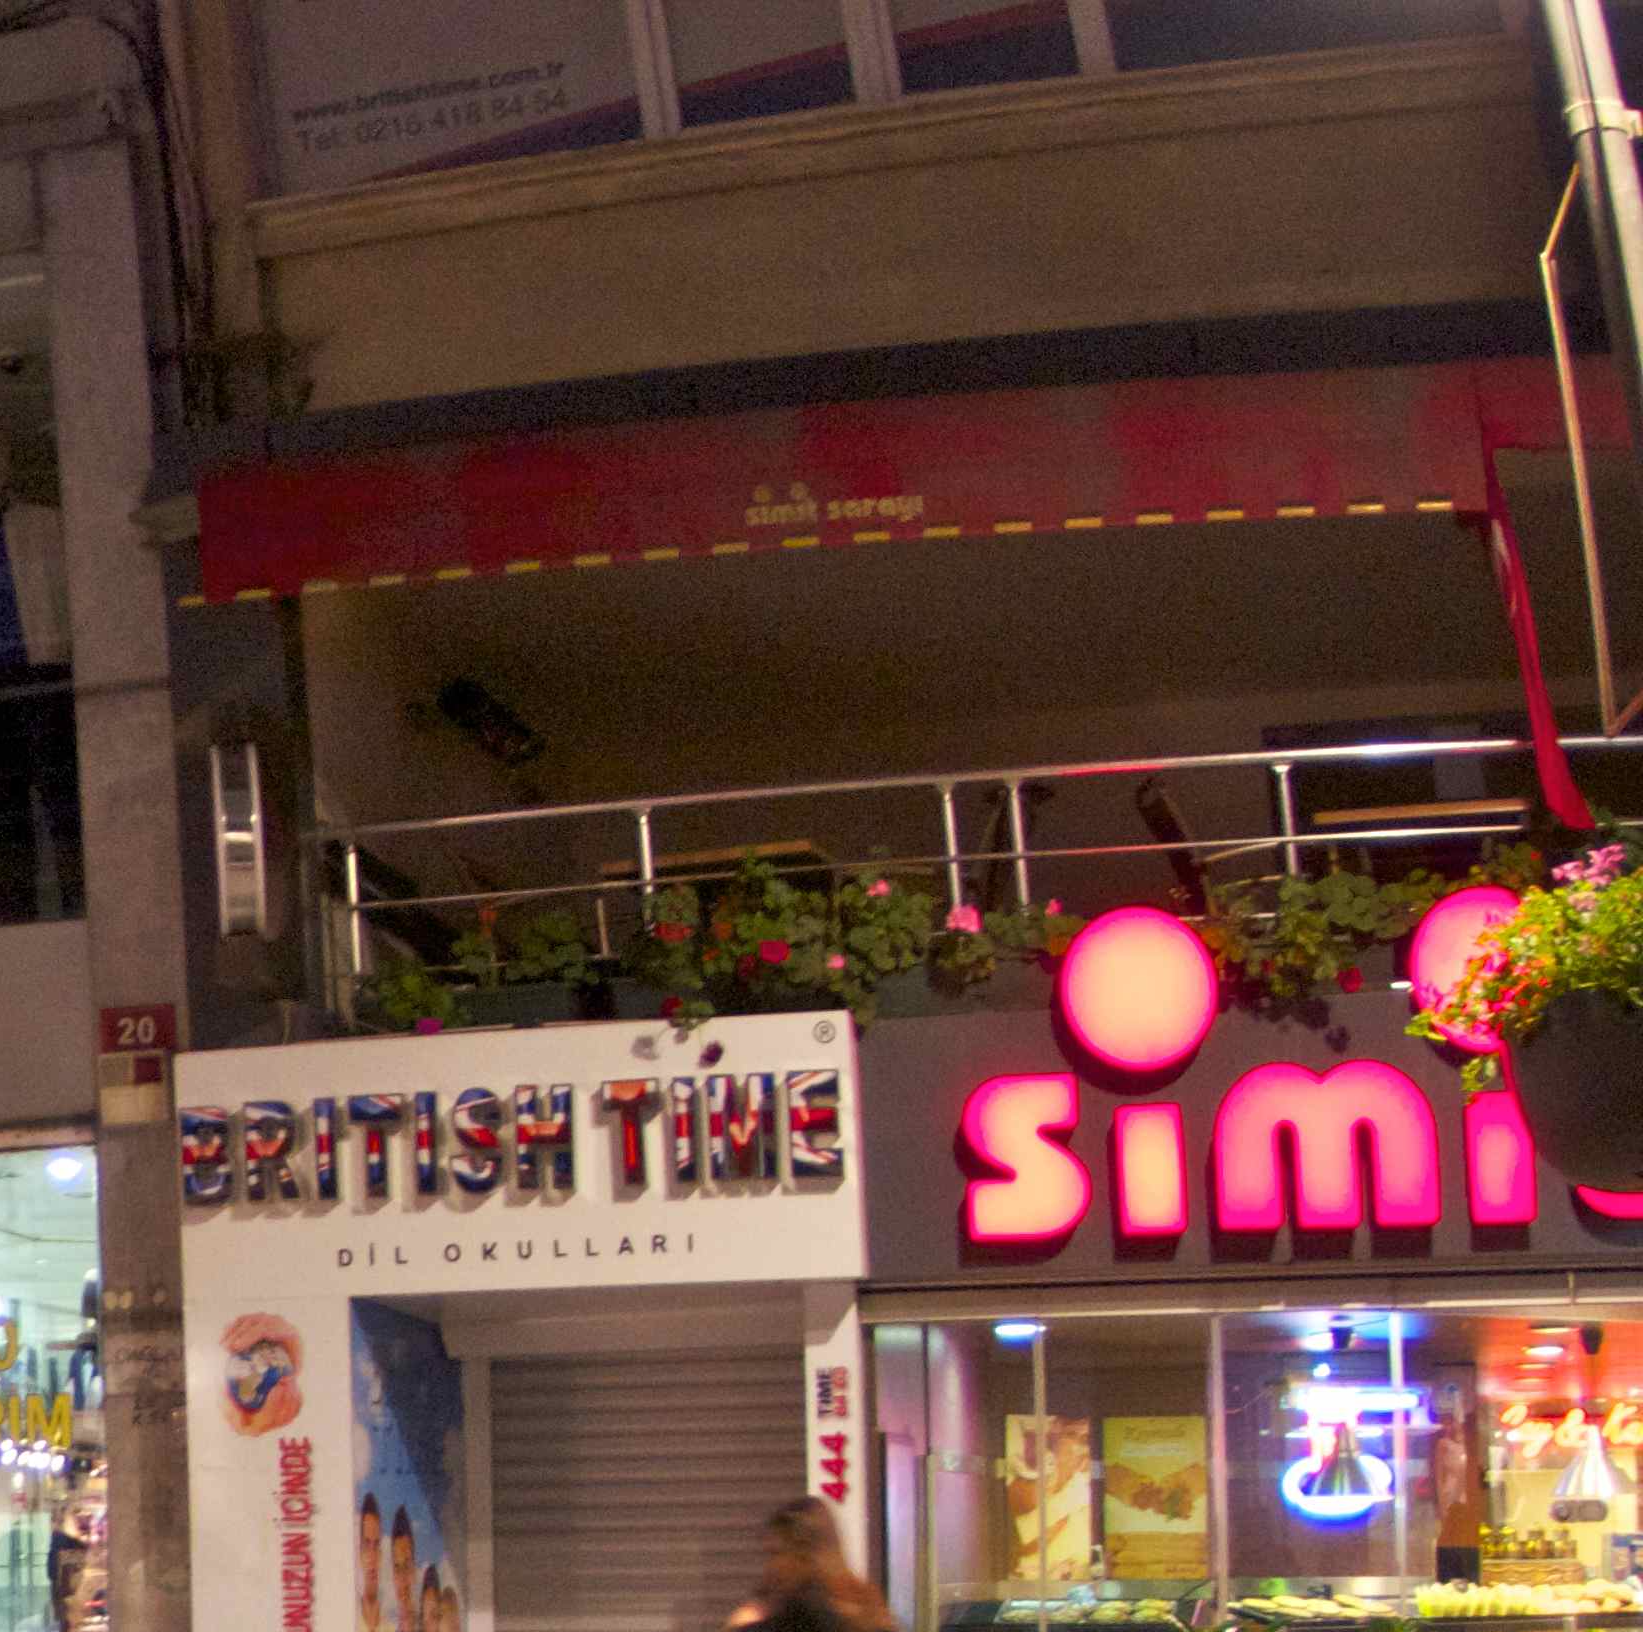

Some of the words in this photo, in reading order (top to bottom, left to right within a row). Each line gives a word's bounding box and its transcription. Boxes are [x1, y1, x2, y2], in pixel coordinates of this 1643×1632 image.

[116, 1015, 156, 1044] 20
[338, 1244, 409, 1269] DİL
[443, 1233, 698, 1264] OKULLARI
[819, 1434, 849, 1504] 444
